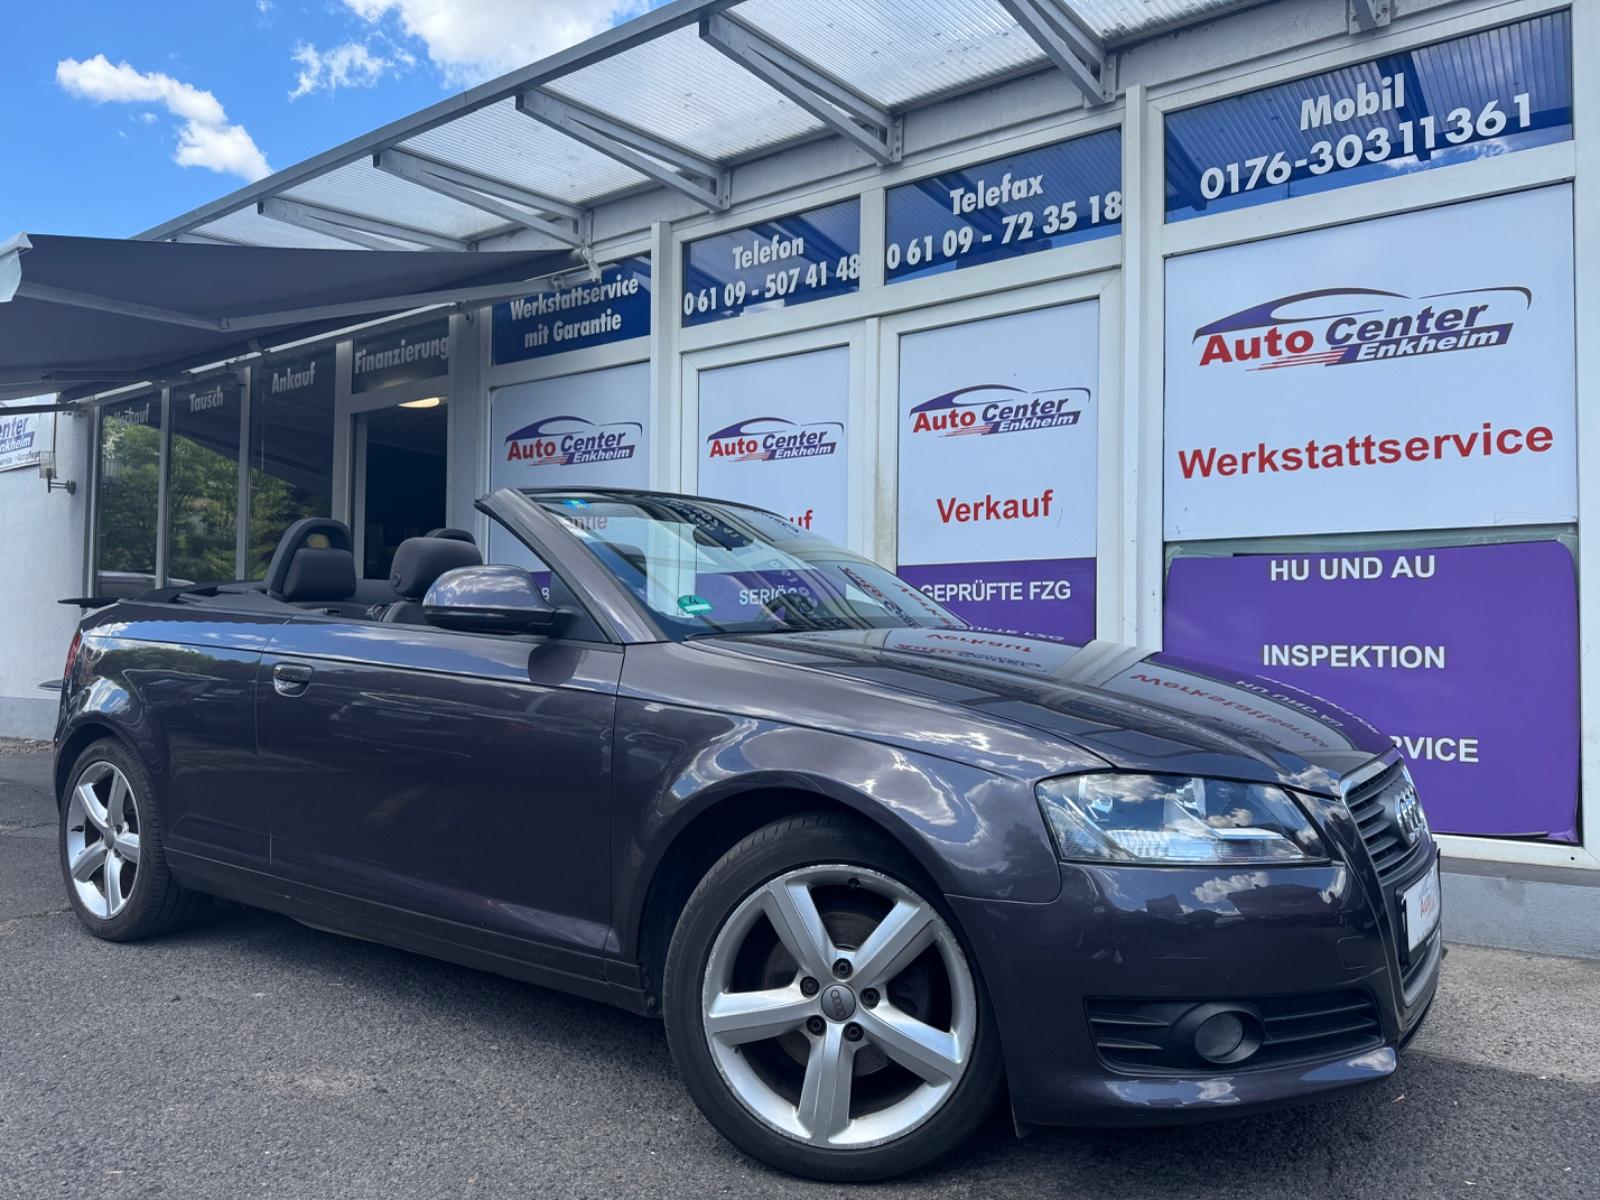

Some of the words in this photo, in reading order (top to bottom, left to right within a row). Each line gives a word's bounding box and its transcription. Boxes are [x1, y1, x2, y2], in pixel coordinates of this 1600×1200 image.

[1300, 73, 1405, 131] Mobil
[1200, 93, 1532, 200] 0176-30311361
[950, 173, 1043, 215] Telefax
[886, 243, 900, 270] 0
[906, 235, 932, 265] 61
[943, 226, 973, 257] 09
[1001, 211, 1034, 245] 72
[1043, 201, 1077, 235] 35
[1089, 191, 1121, 224] 18
[732, 234, 804, 271] Telefon
[510, 274, 639, 321] Werkstattservice
[684, 292, 694, 316] 0
[697, 287, 717, 313] 61
[724, 281, 746, 307] 09
[764, 268, 801, 299] 507
[805, 261, 827, 288] 41
[836, 254, 861, 281] 48
[524, 324, 550, 348] mit
[553, 308, 622, 342] Garantie
[1199, 327, 1314, 366] Auto
[1325, 305, 1489, 346] Center
[1355, 328, 1500, 362] Enkheim
[354, 337, 449, 374] Finanzierung
[271, 361, 316, 394] Ankauf
[189, 385, 224, 413] Tausch
[913, 409, 976, 433] Auto
[982, 398, 1069, 422] Center
[998, 412, 1074, 433] Enkheim
[507, 440, 556, 461] Auto
[560, 430, 626, 453] Center
[573, 447, 631, 464] Enkheim
[709, 439, 758, 458] Auto
[762, 429, 828, 451] Center
[775, 445, 833, 460] Enkheim
[1178, 422, 1554, 479] Werkstattservice
[937, 489, 1054, 523] Verkauf
[1270, 559, 1310, 581] HU
[1320, 557, 1383, 580] UND
[1391, 555, 1435, 578] AU
[920, 579, 1023, 602] GEPRÜFTE
[1029, 580, 1071, 600] FZG
[1263, 645, 1446, 669] INSPEKTION
